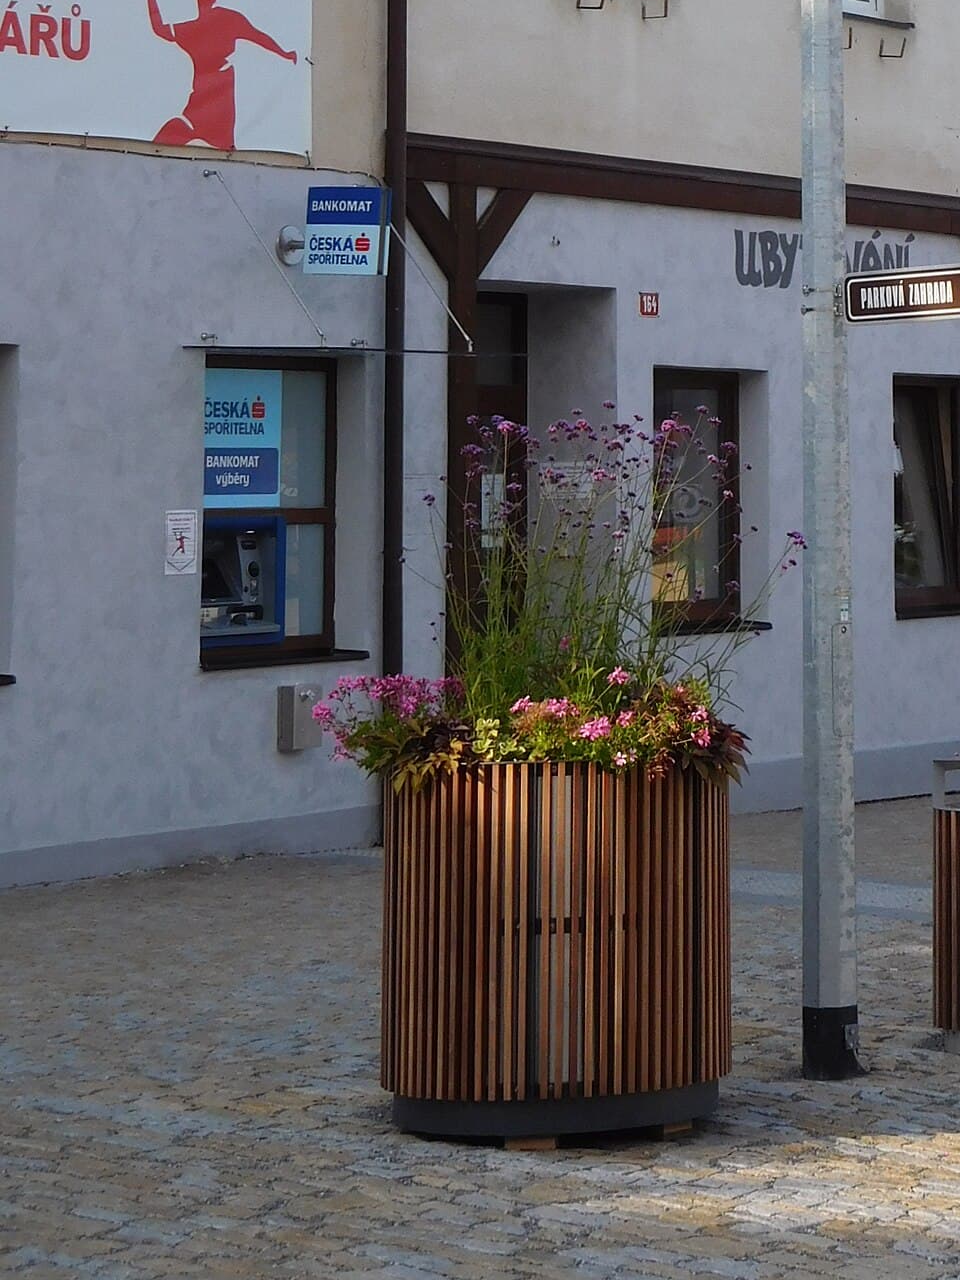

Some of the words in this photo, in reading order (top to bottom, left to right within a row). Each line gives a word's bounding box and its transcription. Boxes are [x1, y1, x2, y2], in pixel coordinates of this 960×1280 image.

[311, 200, 373, 213] BANKOMAT
[309, 234, 354, 252] ČESKÁ
[308, 252, 368, 266] SPOŘITELNA
[860, 279, 905, 310] PARKOVÁ
[908, 280, 954, 306] ZAHRADA
[204, 396, 250, 419] ČESKÁ
[204, 419, 265, 435] SPOŘITELNA
[206, 455, 259, 468] BANKOMAT
[215, 472, 250, 488] výběry
